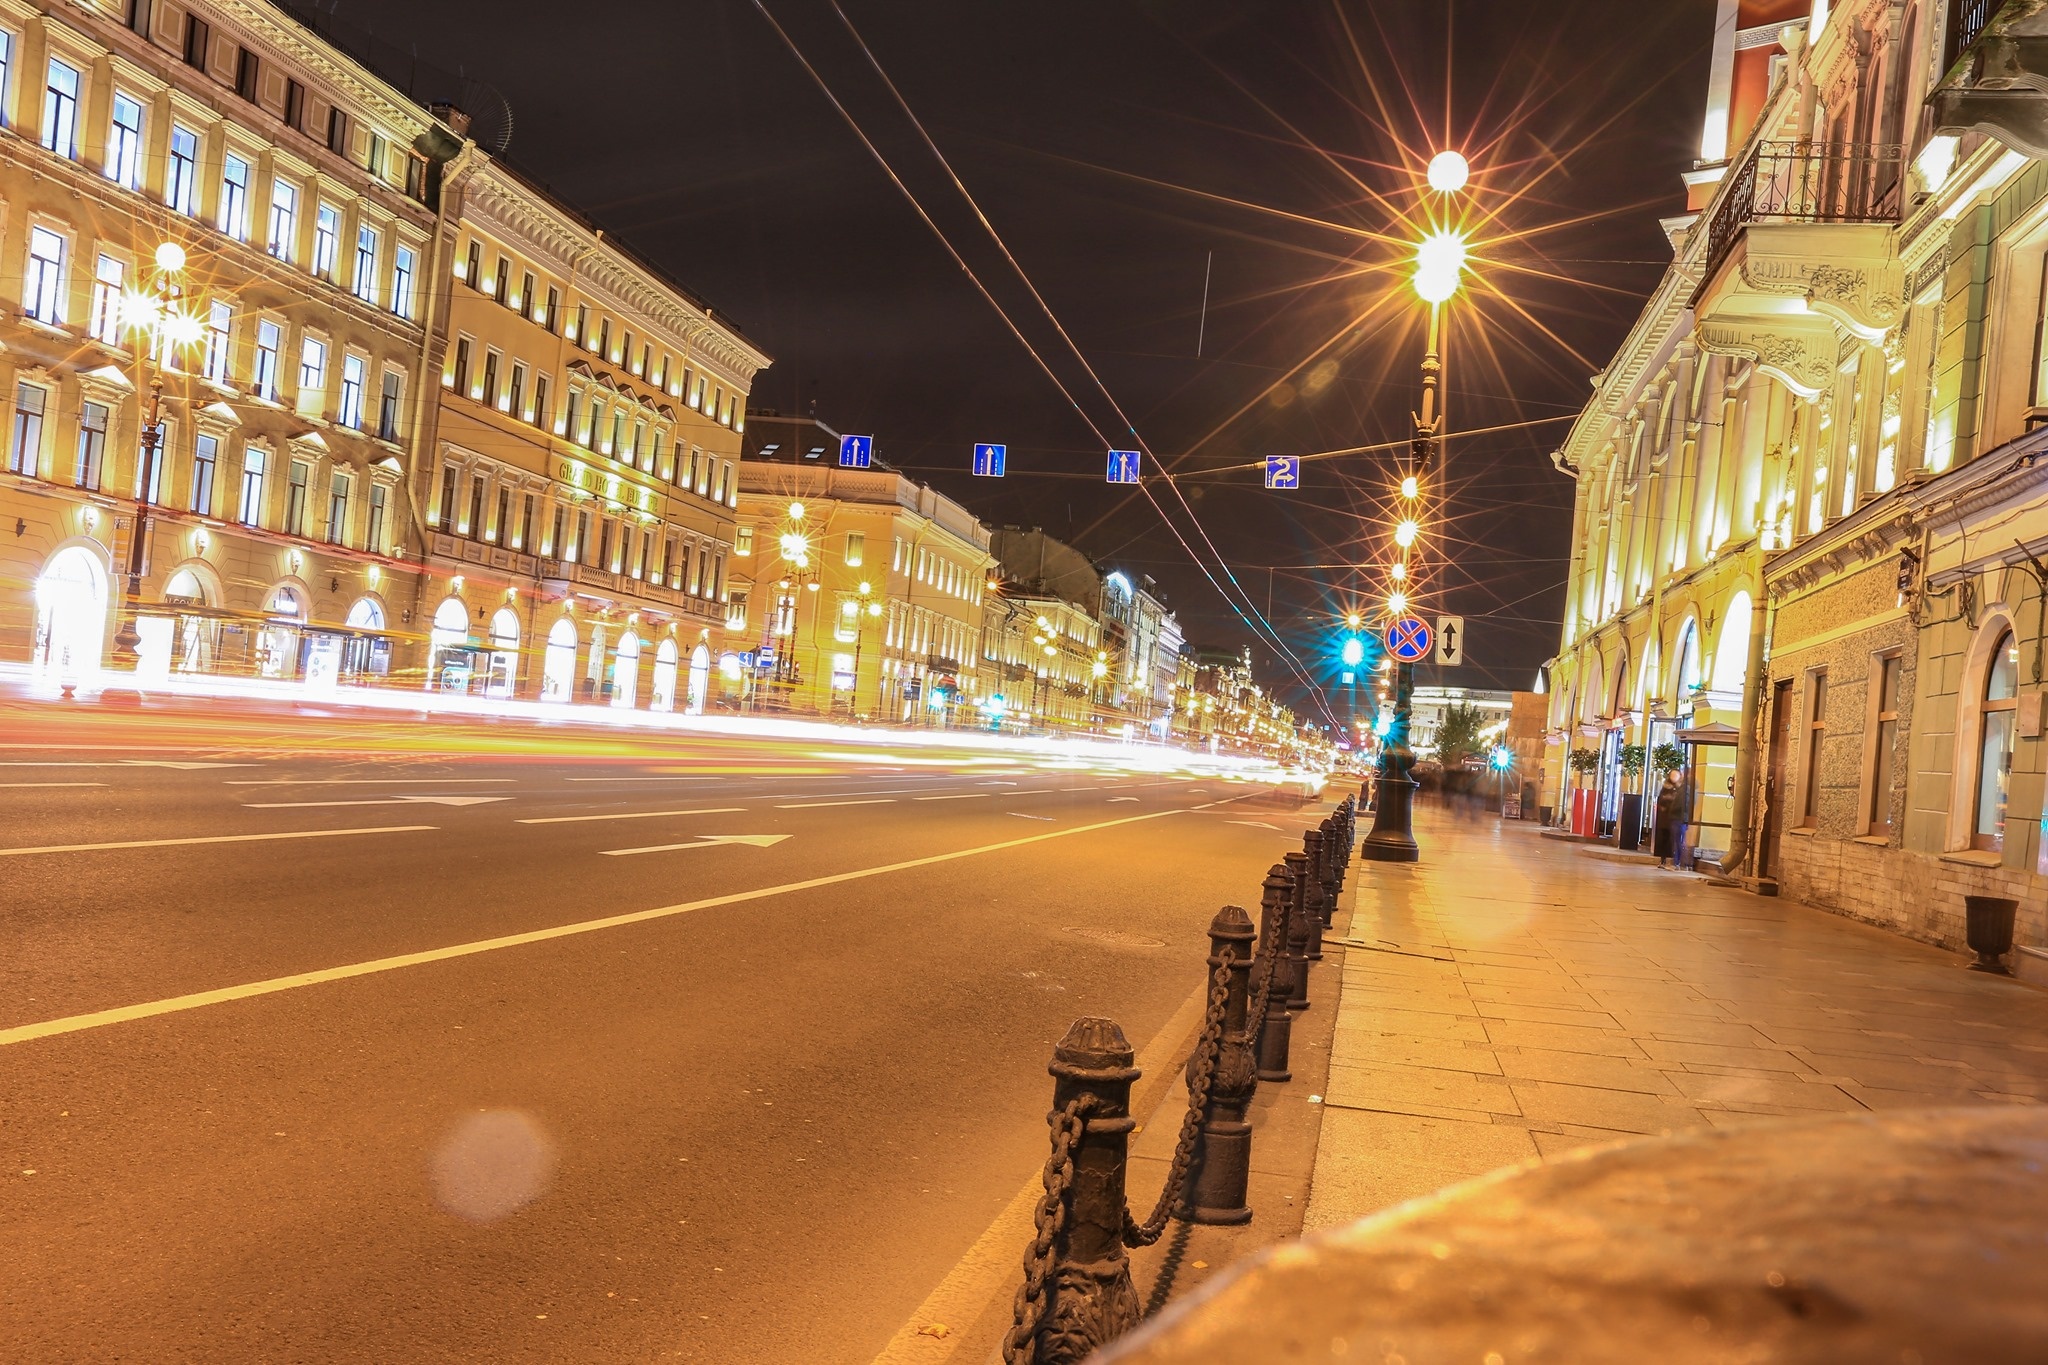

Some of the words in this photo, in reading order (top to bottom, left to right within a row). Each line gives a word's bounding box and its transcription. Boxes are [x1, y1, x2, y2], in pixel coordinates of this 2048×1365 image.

[559, 462, 592, 488] GRAD
[595, 475, 625, 499] HOL
[627, 488, 658, 512] EUPE
